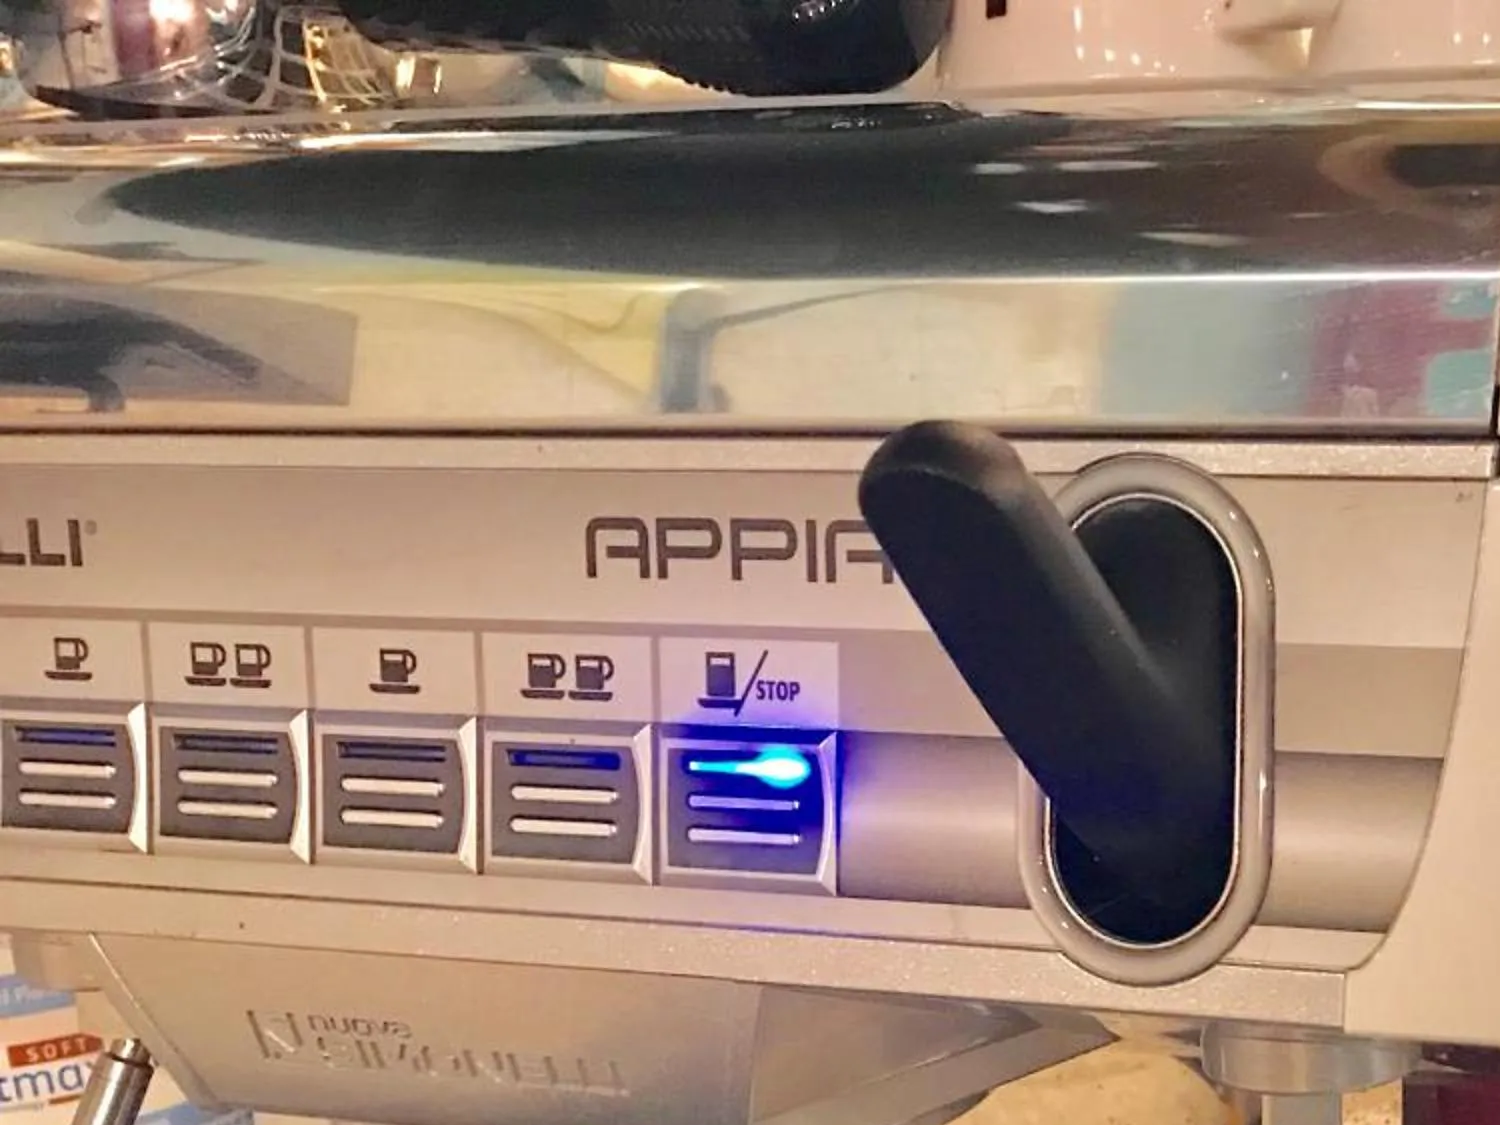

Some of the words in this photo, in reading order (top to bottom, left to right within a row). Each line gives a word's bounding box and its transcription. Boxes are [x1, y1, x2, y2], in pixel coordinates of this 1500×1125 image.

[585, 517, 893, 584] APPIA
[756, 680, 801, 701] STOP
[25, 1037, 88, 1063] SOFT
